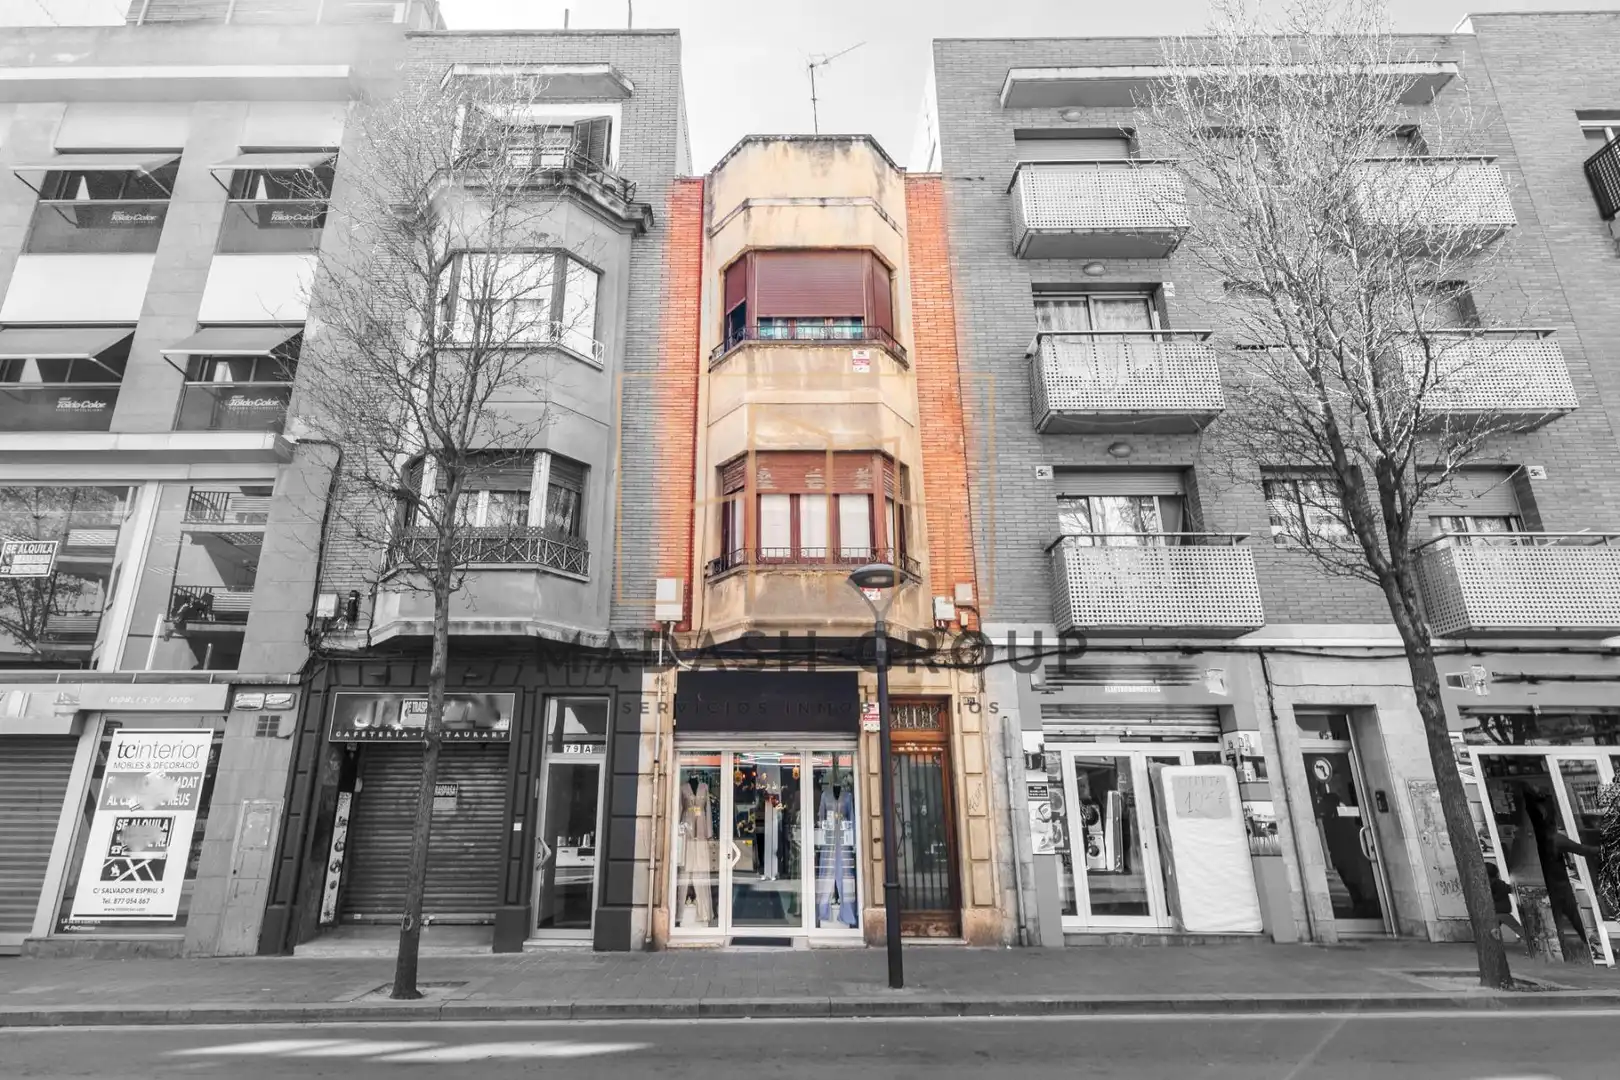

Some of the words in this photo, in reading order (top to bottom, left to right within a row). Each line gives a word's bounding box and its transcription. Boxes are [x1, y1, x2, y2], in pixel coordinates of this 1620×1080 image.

[5, 544, 18, 554] SE
[18, 544, 53, 554] ALQUILA
[117, 739, 204, 759] tcinterior
[566, 745, 579, 753] 79
[585, 745, 591, 753] A
[153, 760, 199, 769] DECORACIÓ
